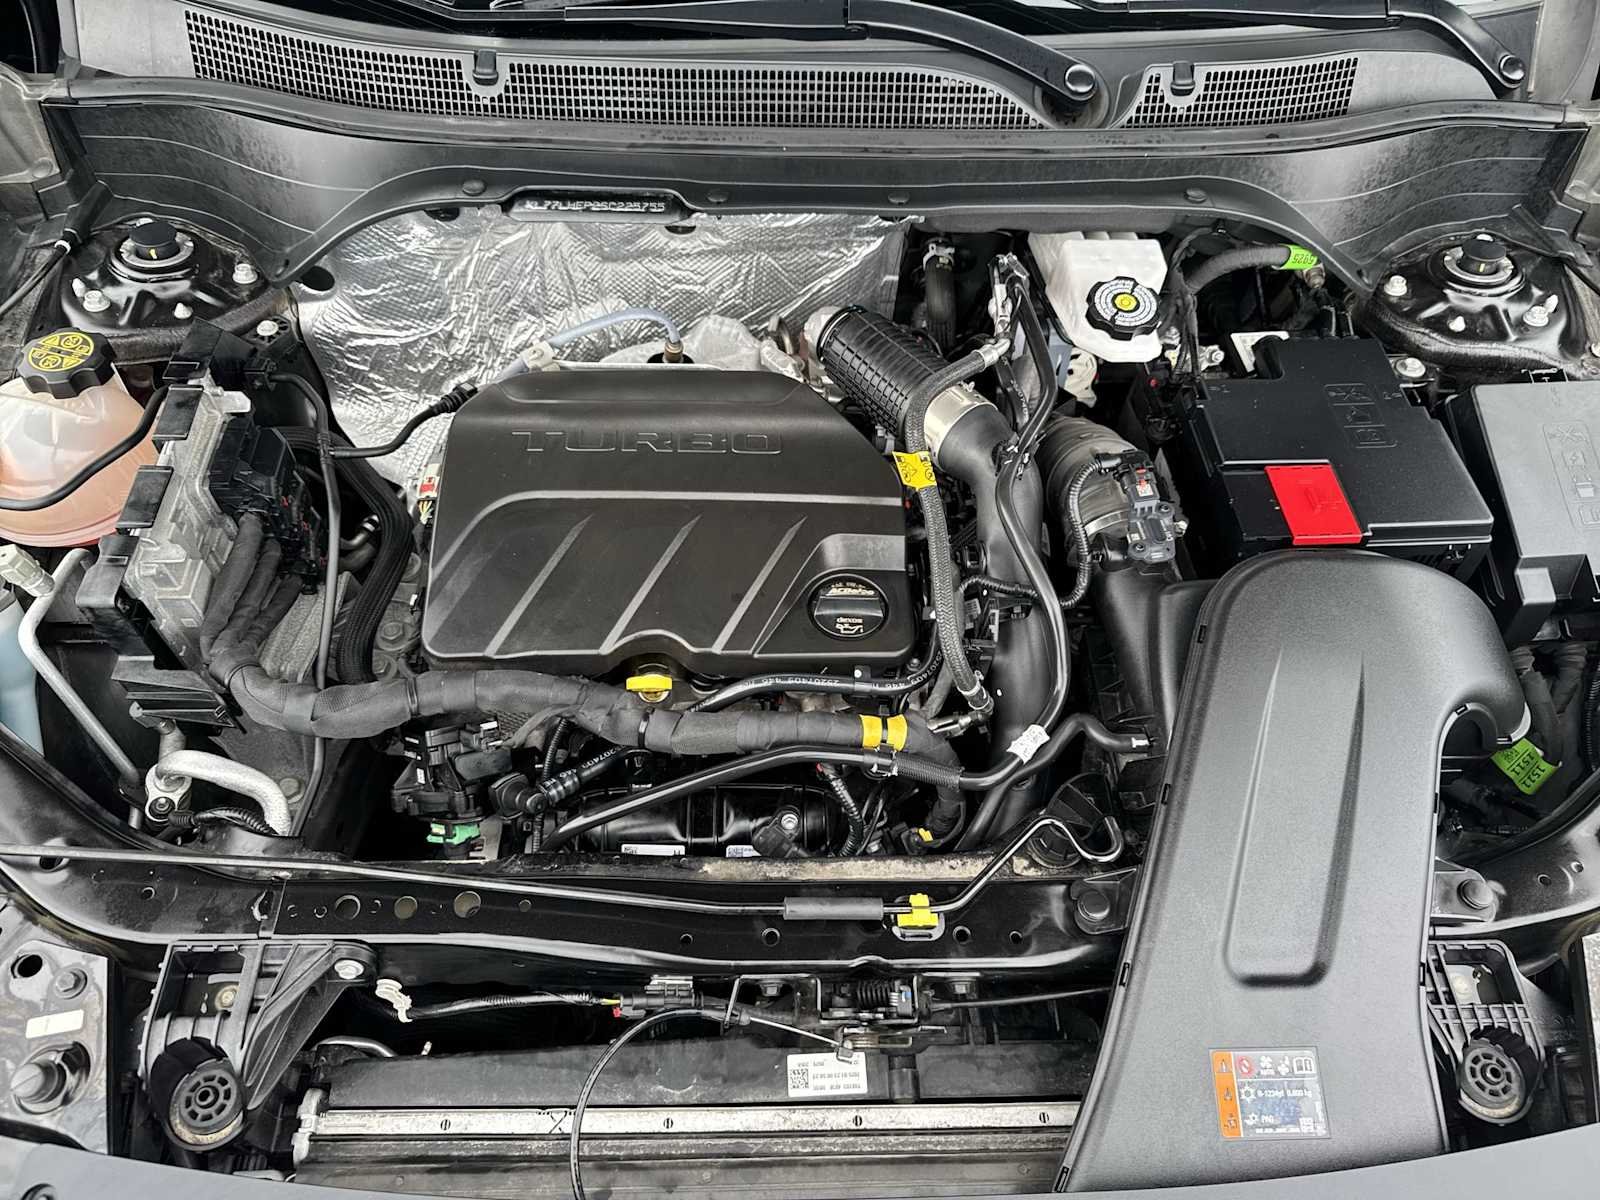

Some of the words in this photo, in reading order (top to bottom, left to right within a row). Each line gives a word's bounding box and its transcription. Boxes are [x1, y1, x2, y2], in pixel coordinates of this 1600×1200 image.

[511, 429, 781, 454] TURBO
[1509, 751, 1535, 776] 1511
[1521, 765, 1546, 788] 1511
